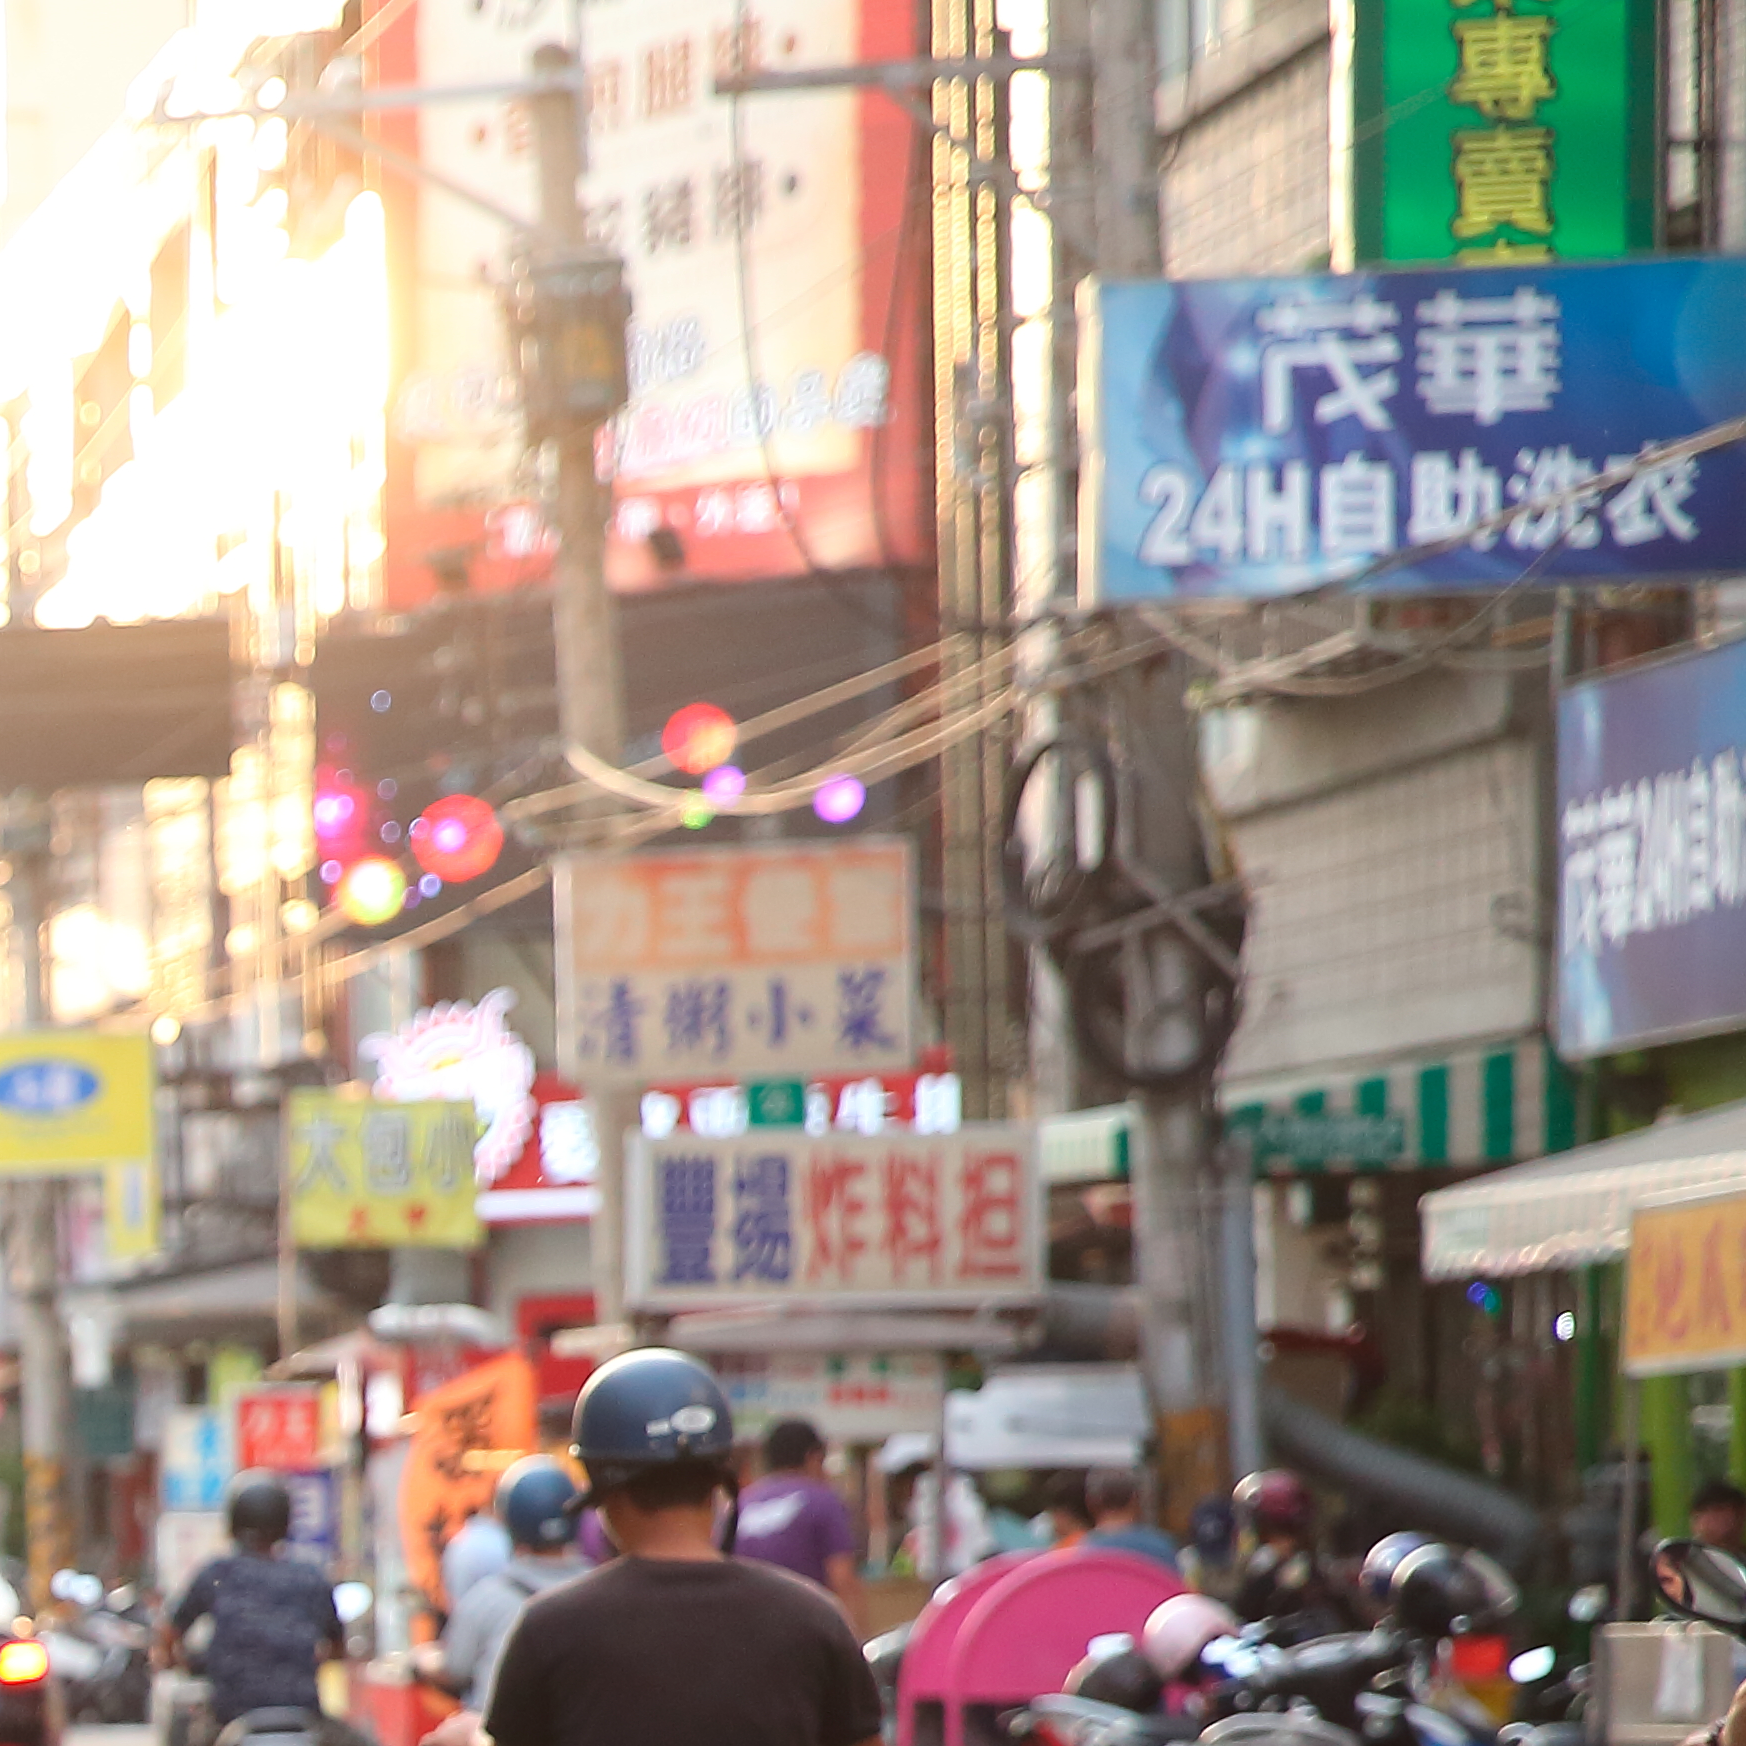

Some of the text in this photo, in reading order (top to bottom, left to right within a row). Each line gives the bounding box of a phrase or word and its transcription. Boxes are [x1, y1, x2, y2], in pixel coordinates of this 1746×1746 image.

[1447, 0, 1557, 264] 專賣
[1255, 287, 1562, 433] 茂華
[573, 966, 901, 1066] 清粥小菜
